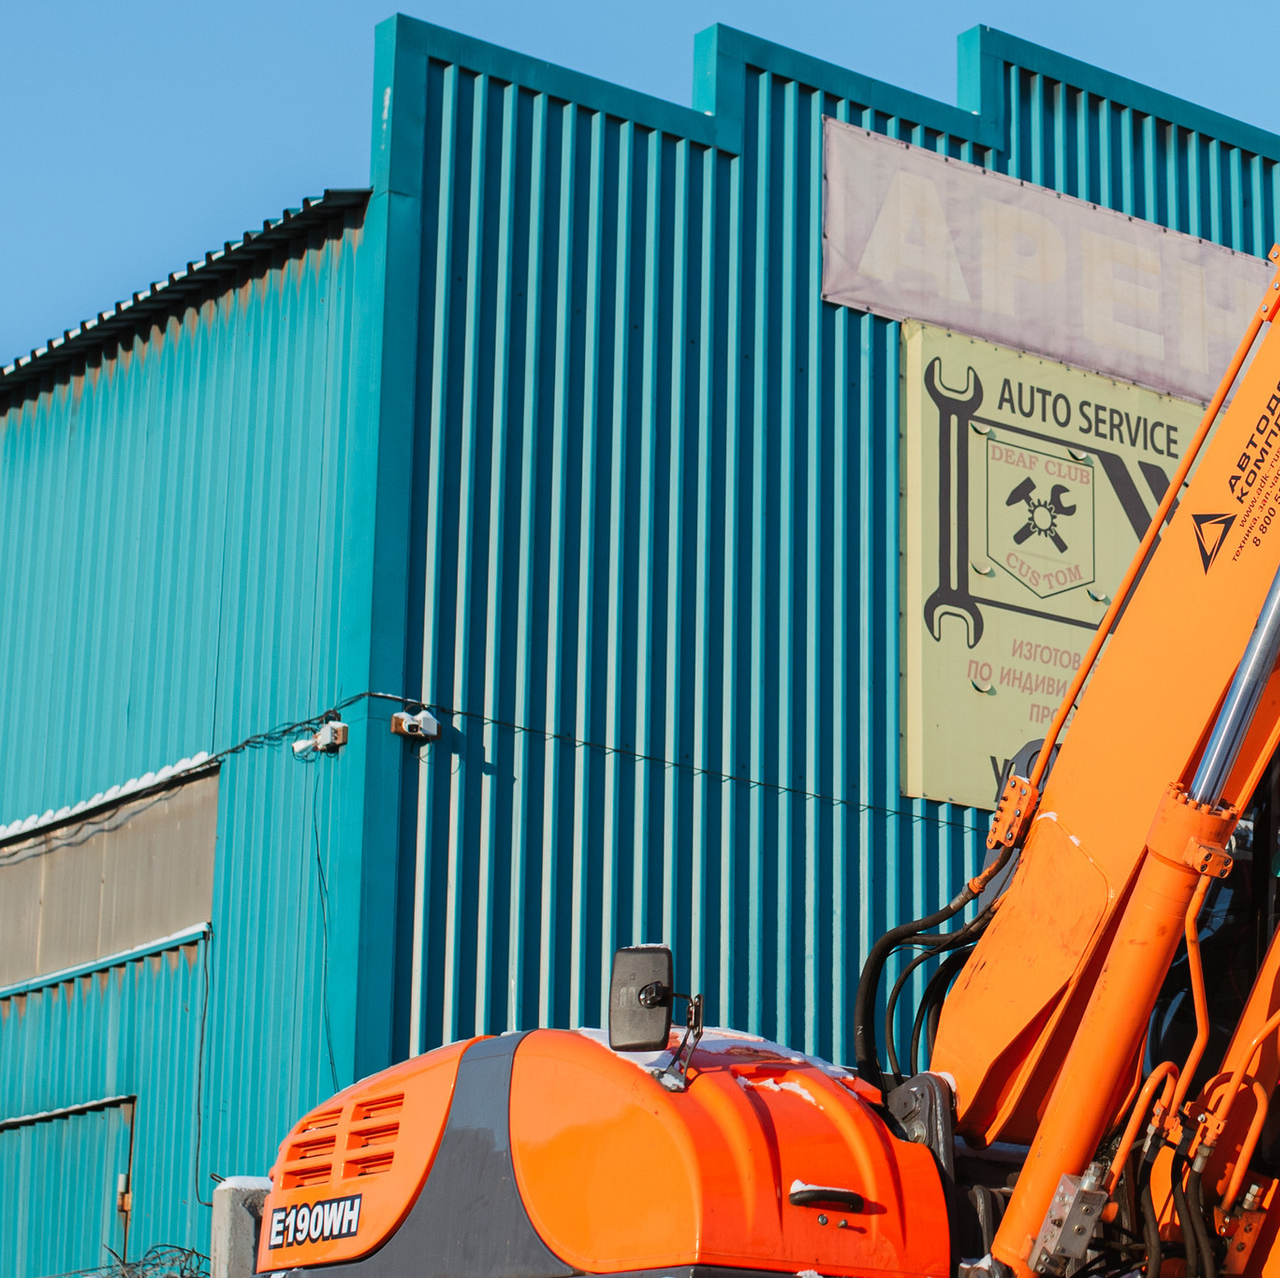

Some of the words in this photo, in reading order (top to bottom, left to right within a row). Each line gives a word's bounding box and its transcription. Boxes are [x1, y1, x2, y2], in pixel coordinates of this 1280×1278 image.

[997, 378, 1071, 428] AUTO
[1078, 400, 1179, 460] SERVICE
[990, 444, 1040, 472] DEAF
[1044, 459, 1092, 486] CLUB
[1252, 536, 1261, 547] 8
[1258, 506, 1277, 534] 800
[1005, 551, 1084, 590] CUSTOM
[967, 659, 994, 682] ПО
[269, 1196, 361, 1248] E190WH
